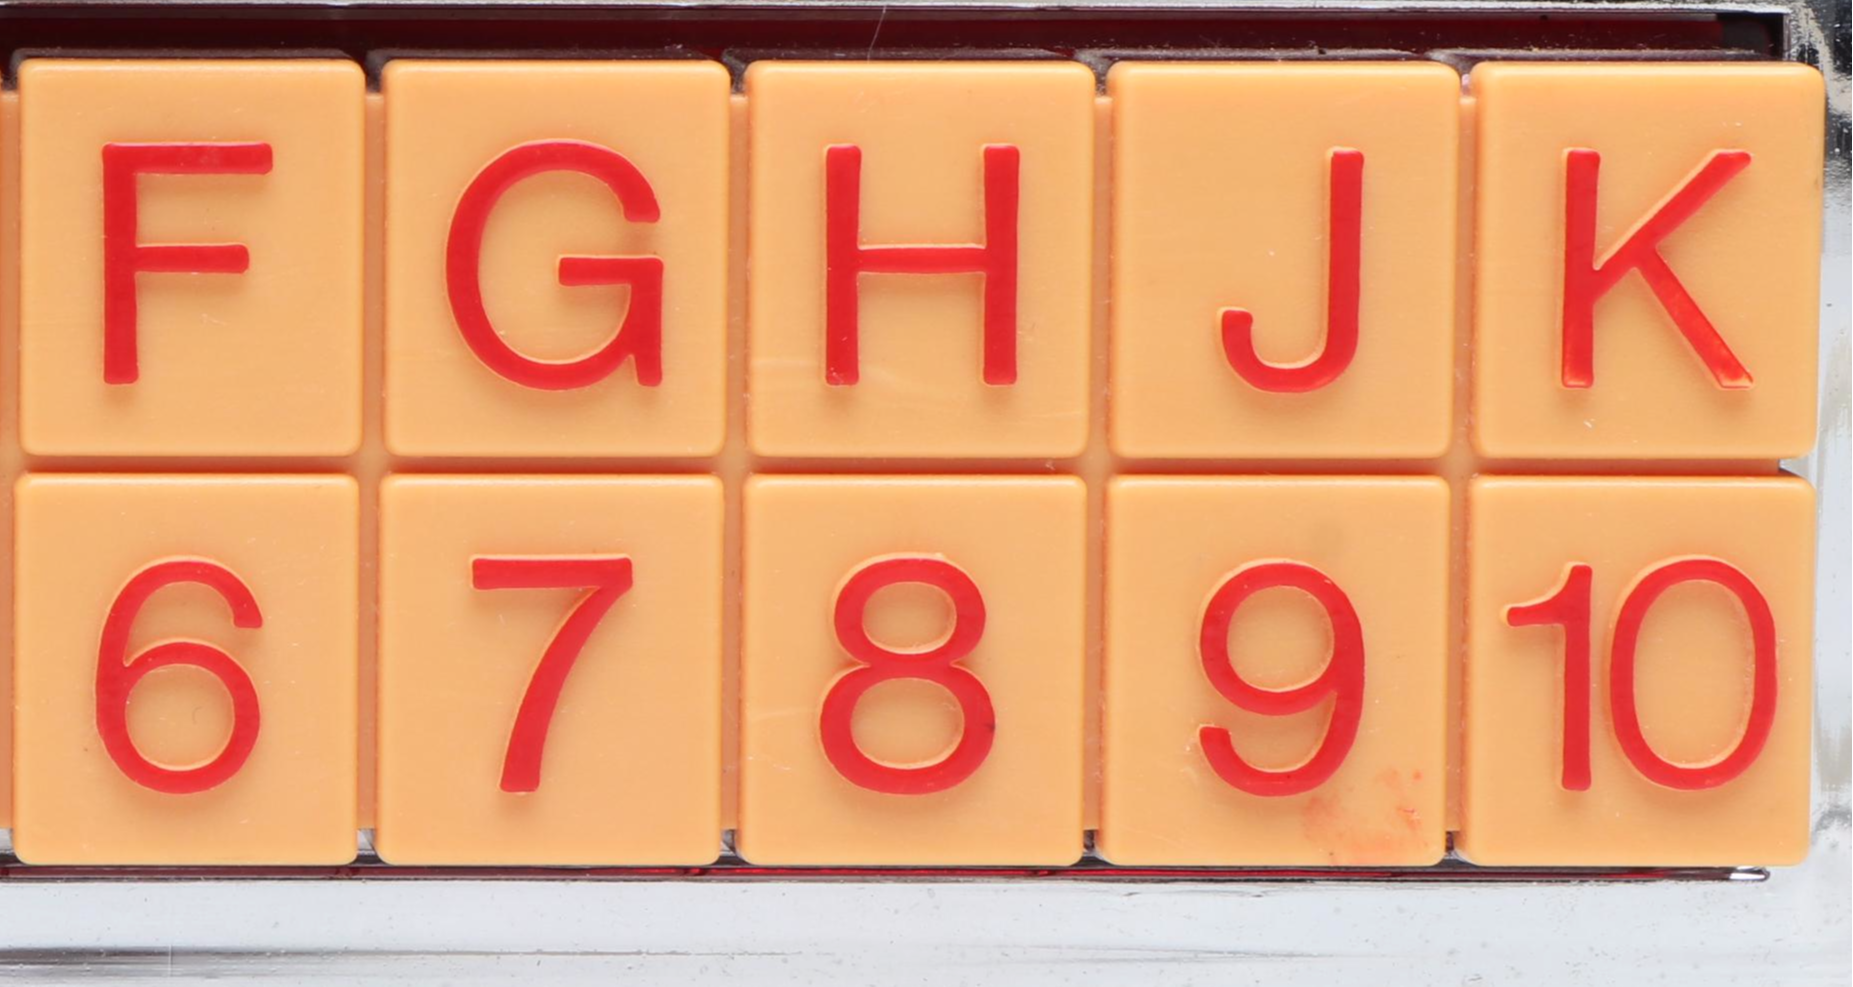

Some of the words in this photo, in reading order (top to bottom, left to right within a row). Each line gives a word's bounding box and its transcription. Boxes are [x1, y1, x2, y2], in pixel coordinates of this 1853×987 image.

[101, 142, 274, 385] F
[445, 142, 664, 390] G
[824, 145, 1021, 387] H
[1219, 149, 1365, 393] J
[1560, 149, 1754, 389] K
[95, 559, 264, 795] 6
[471, 557, 634, 793] 7
[819, 556, 996, 796] 8
[1199, 560, 1366, 797] 9
[1501, 559, 1779, 792] 10
